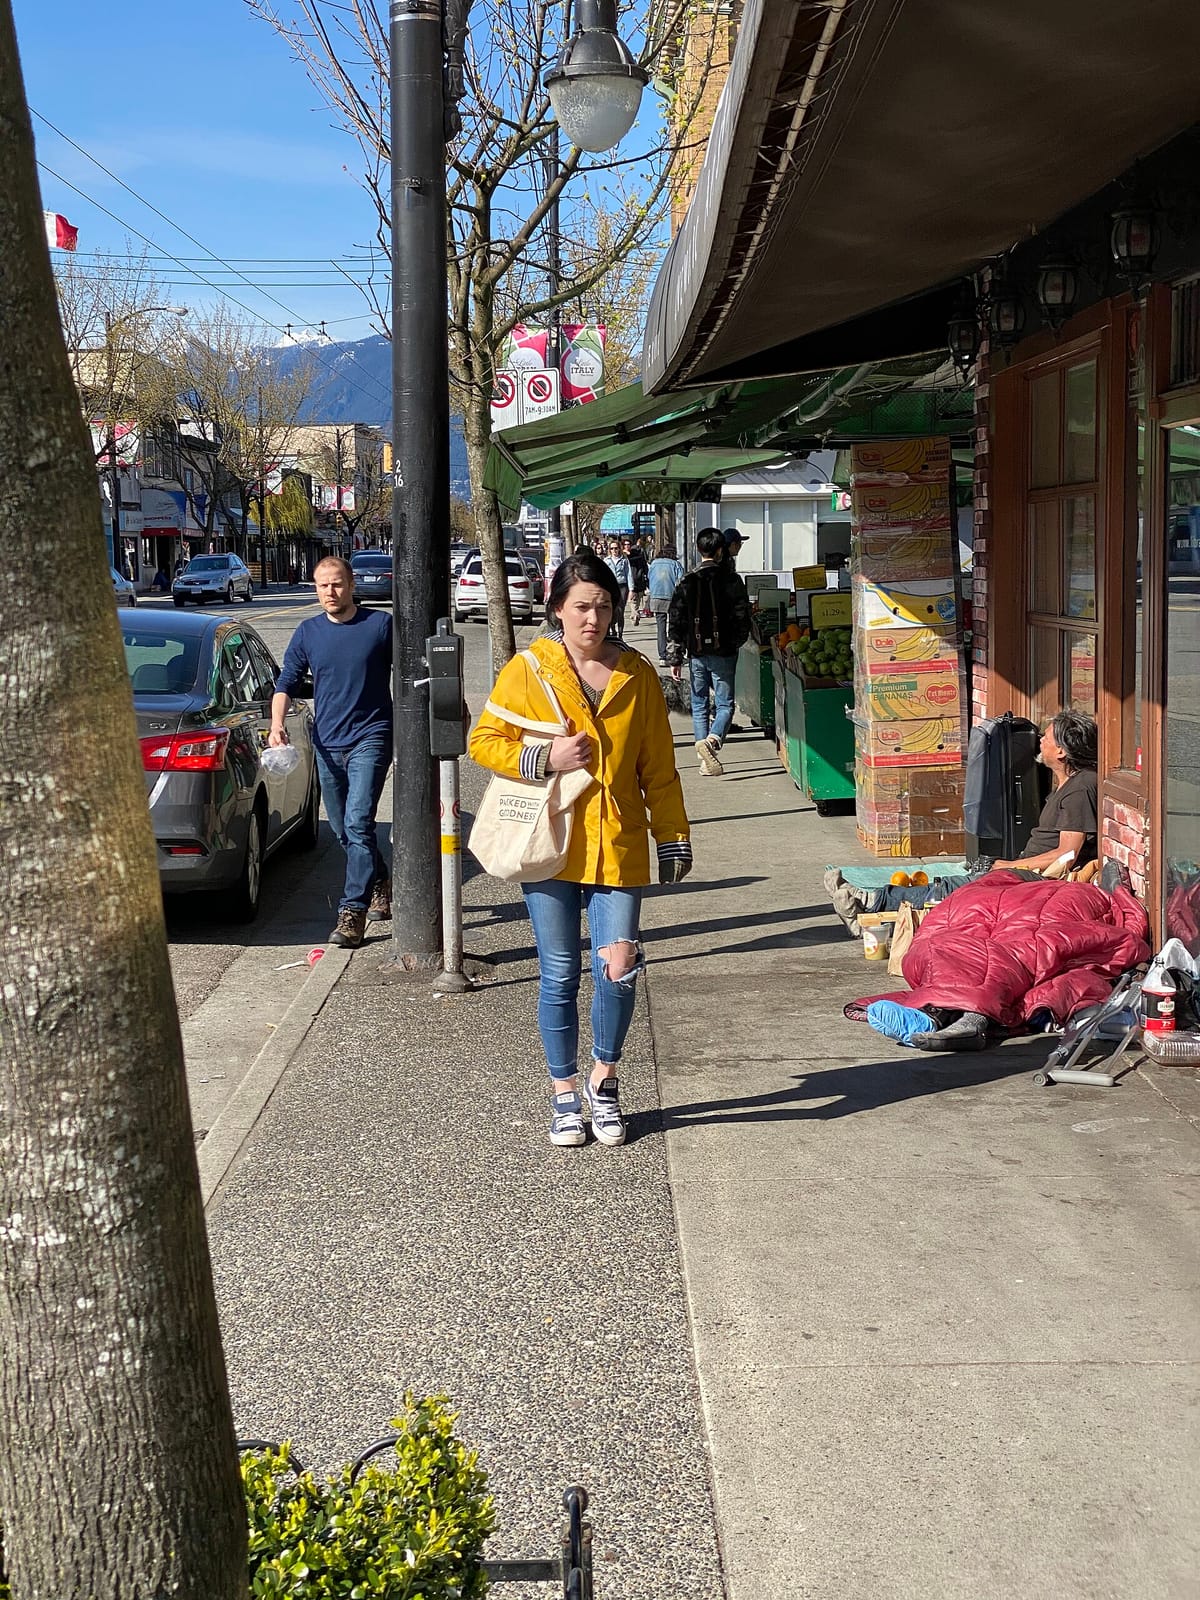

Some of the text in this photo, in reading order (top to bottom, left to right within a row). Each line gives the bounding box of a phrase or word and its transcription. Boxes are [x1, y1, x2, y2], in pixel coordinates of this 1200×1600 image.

[571, 366, 595, 374] ITALY
[395, 459, 401, 473] 2
[393, 474, 404, 487] 16
[875, 638, 894, 646] Dole
[872, 684, 907, 692] Premium
[873, 691, 913, 701] BANANAS
